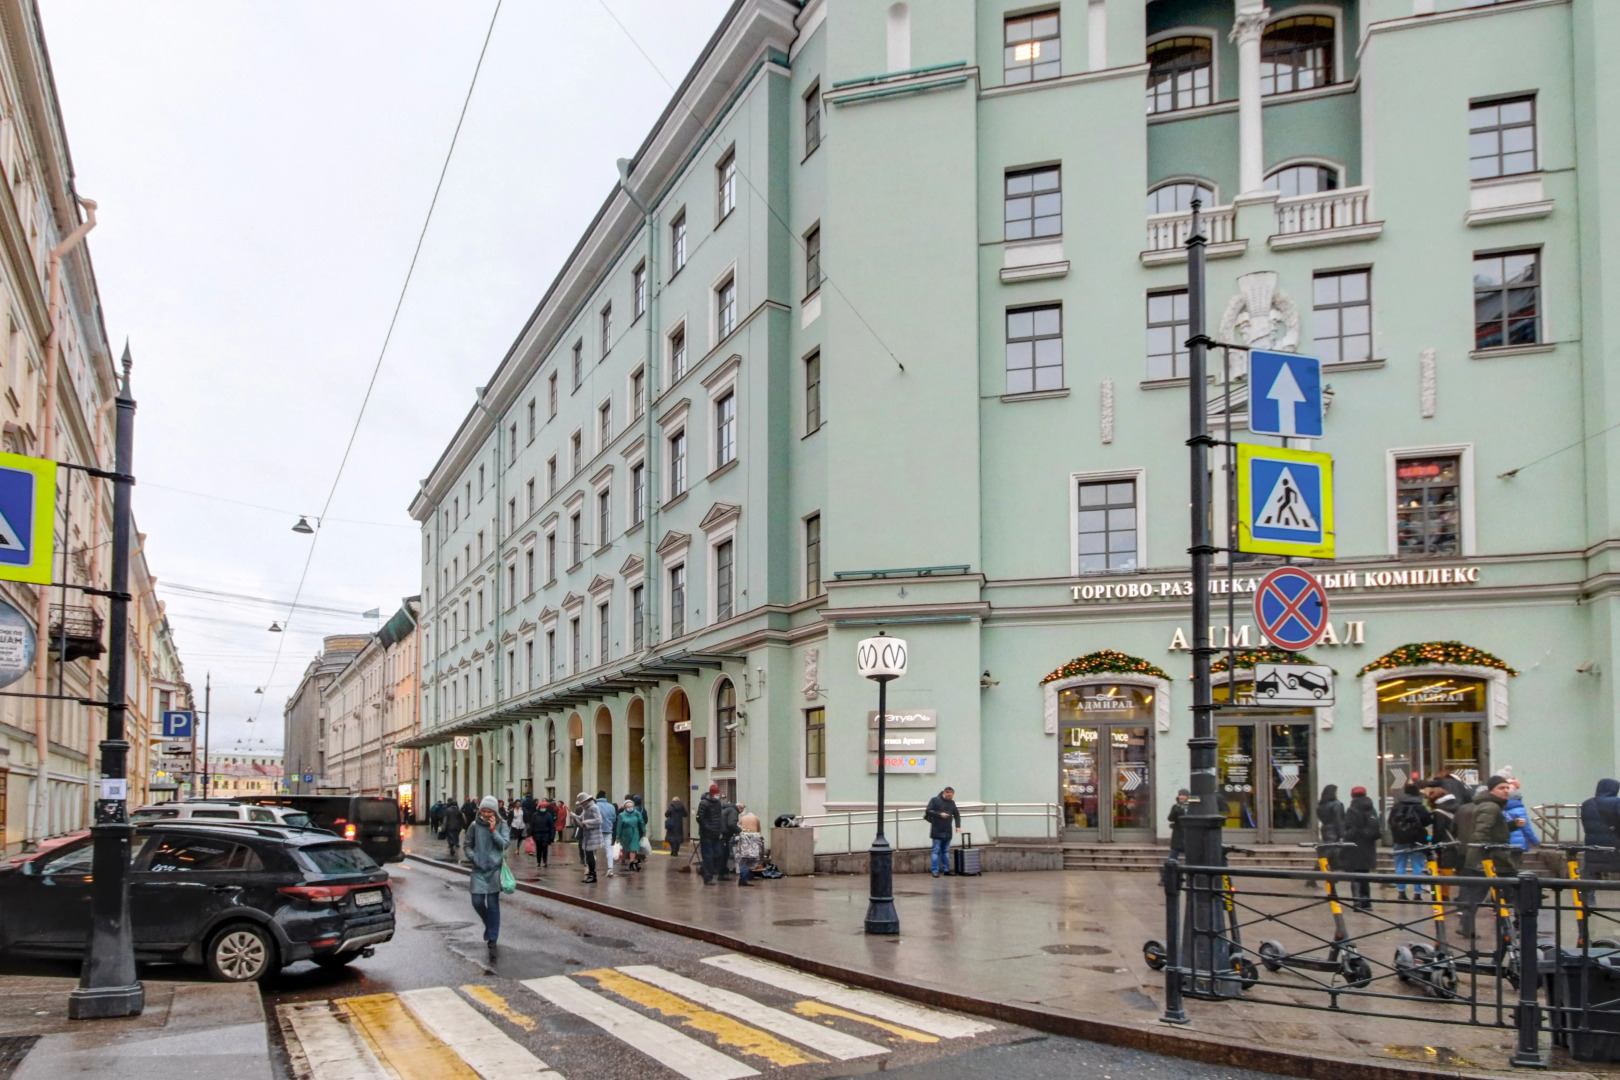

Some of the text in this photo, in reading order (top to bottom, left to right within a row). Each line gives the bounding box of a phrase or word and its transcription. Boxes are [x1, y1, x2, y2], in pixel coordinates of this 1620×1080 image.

[1071, 567, 1481, 600] ТОРГОВО-РАЗЛЕКАЫЙ КОМПЛЕКС
[1168, 621, 1365, 650] АМАЛ
[1077, 701, 1133, 710] АДМИРАЛ
[1398, 693, 1464, 703] АДМИРАЛ
[170, 714, 187, 734] P
